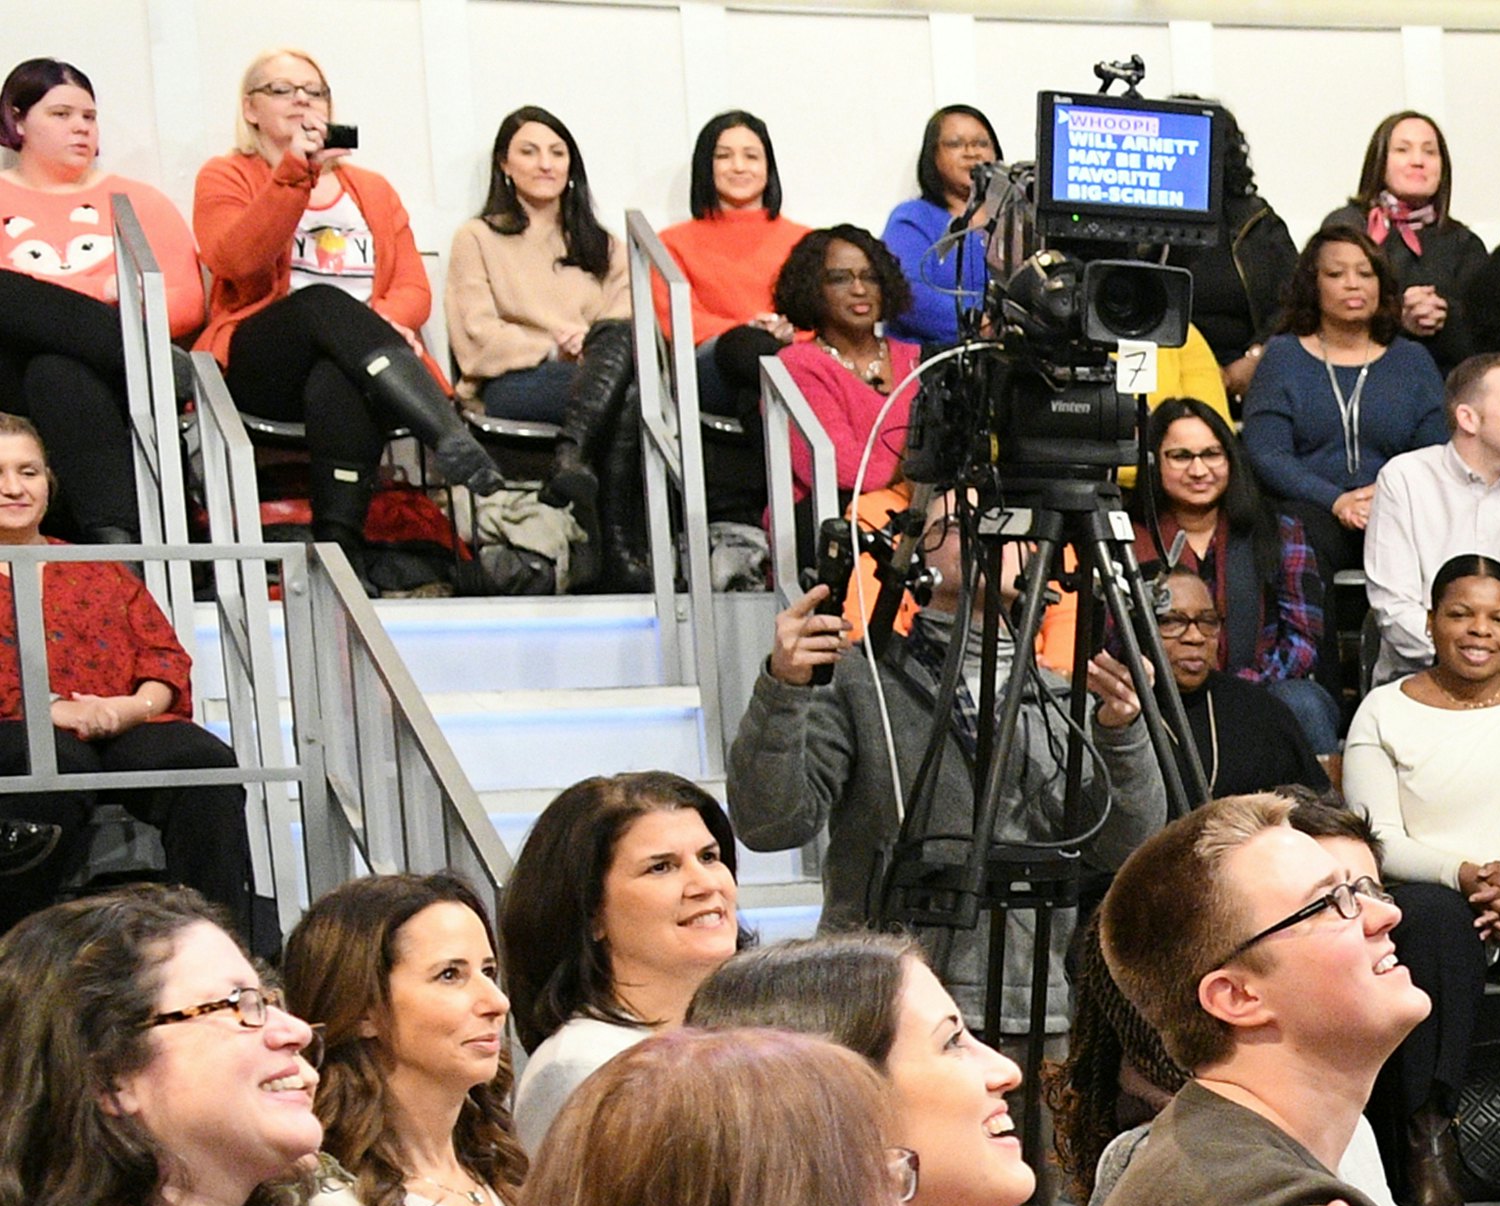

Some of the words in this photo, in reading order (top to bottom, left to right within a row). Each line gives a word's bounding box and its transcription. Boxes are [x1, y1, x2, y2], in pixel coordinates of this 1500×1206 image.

[1070, 114, 1157, 134] WHOOPI:
[1068, 131, 1117, 149] WILL
[1122, 136, 1199, 155] ARNETT
[1068, 148, 1111, 166] MAY
[1115, 151, 1141, 169] BE
[1146, 154, 1177, 171] MY
[1067, 166, 1161, 187] FAVORITE
[1067, 184, 1184, 207] BIG-SCREEN
[1124, 351, 1148, 388] 7
[1051, 400, 1091, 414] Vinten
